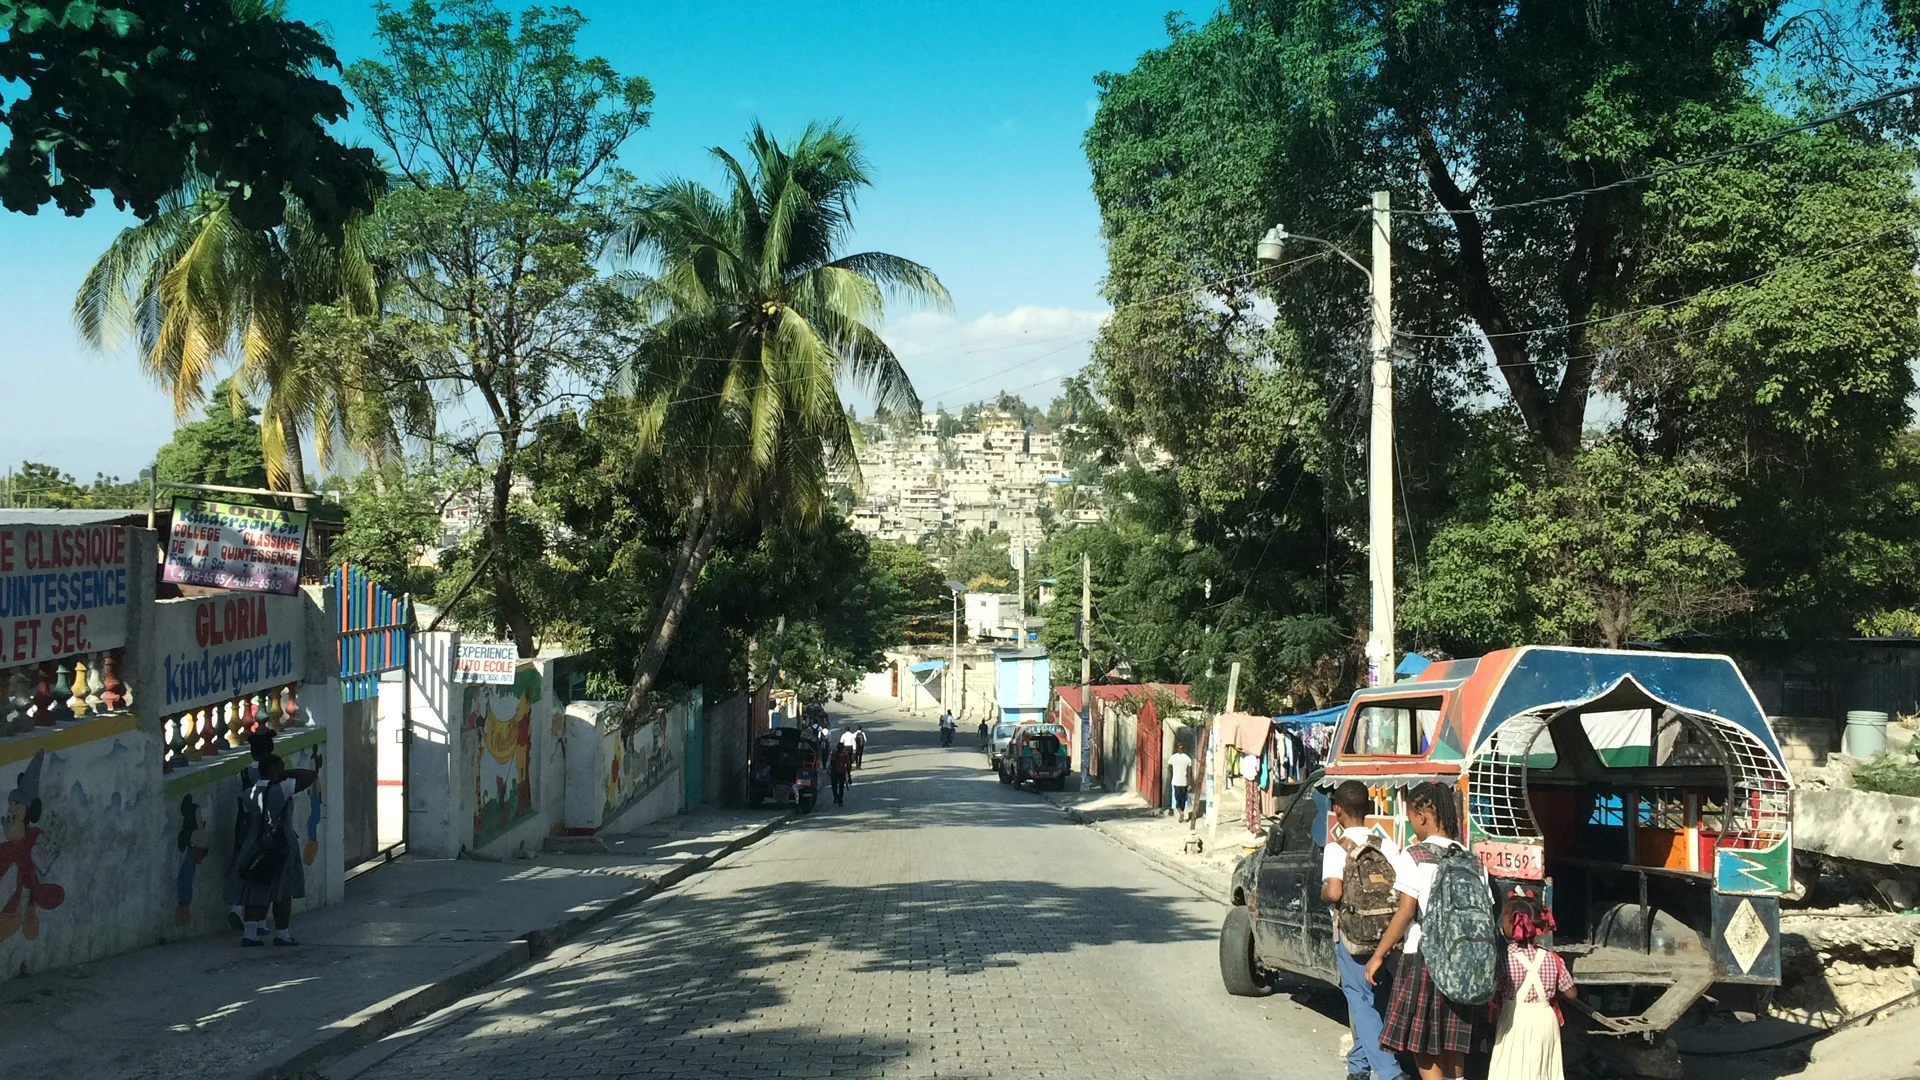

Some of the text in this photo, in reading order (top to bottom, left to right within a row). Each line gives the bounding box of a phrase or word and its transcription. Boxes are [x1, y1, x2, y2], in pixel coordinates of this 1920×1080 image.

[180, 509, 299, 534] Kindergarten
[190, 500, 291, 522] GLORIA
[24, 527, 126, 570] CLASSIQUE
[174, 524, 300, 551] COLLEGE CLASSIQUE
[171, 540, 298, 567] DE LA QUINTESSENCE
[195, 595, 268, 648] GLORIA
[13, 619, 41, 661] ET
[51, 614, 91, 655] SEC.
[455, 659, 514, 673] AUTO ECOLE
[456, 646, 514, 660] EXPERIENCE
[164, 638, 293, 705] kindergarten
